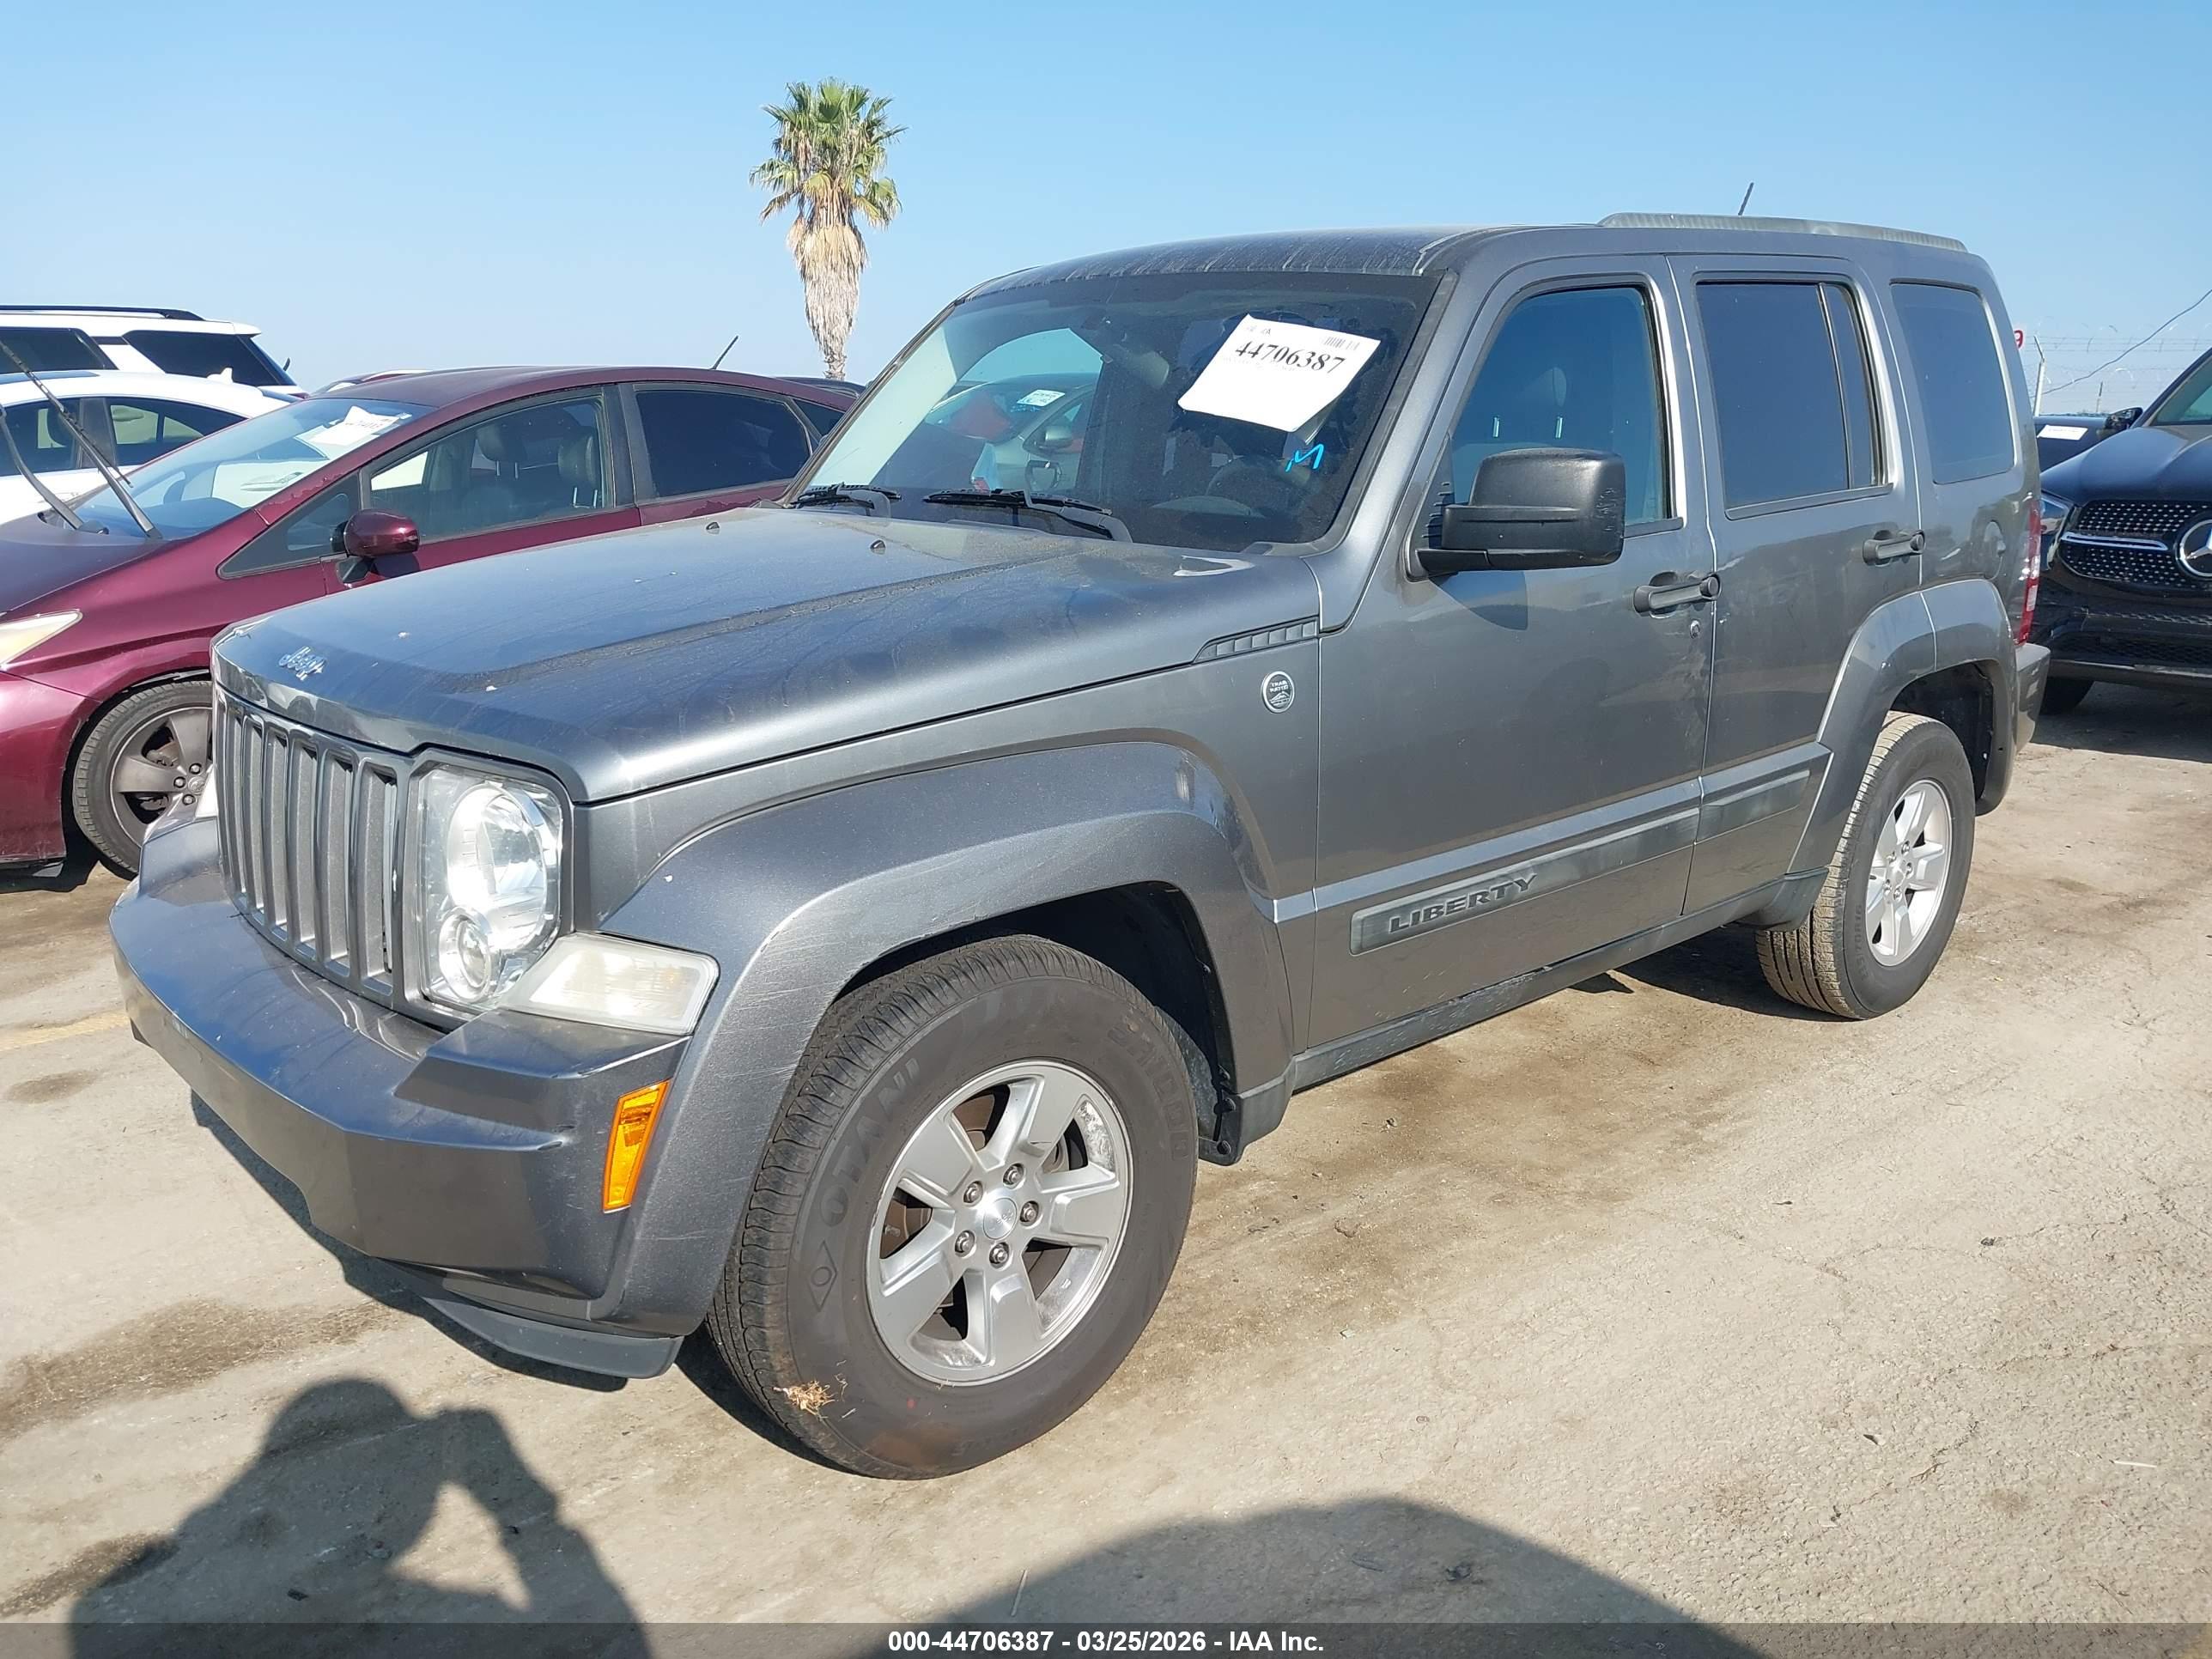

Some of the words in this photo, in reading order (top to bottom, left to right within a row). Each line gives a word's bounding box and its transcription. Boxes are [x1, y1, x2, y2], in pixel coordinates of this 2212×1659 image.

[1234, 341, 1346, 374] 44706387
[277, 646, 327, 681] Jeep
[1389, 872, 1537, 933] LIBERTY
